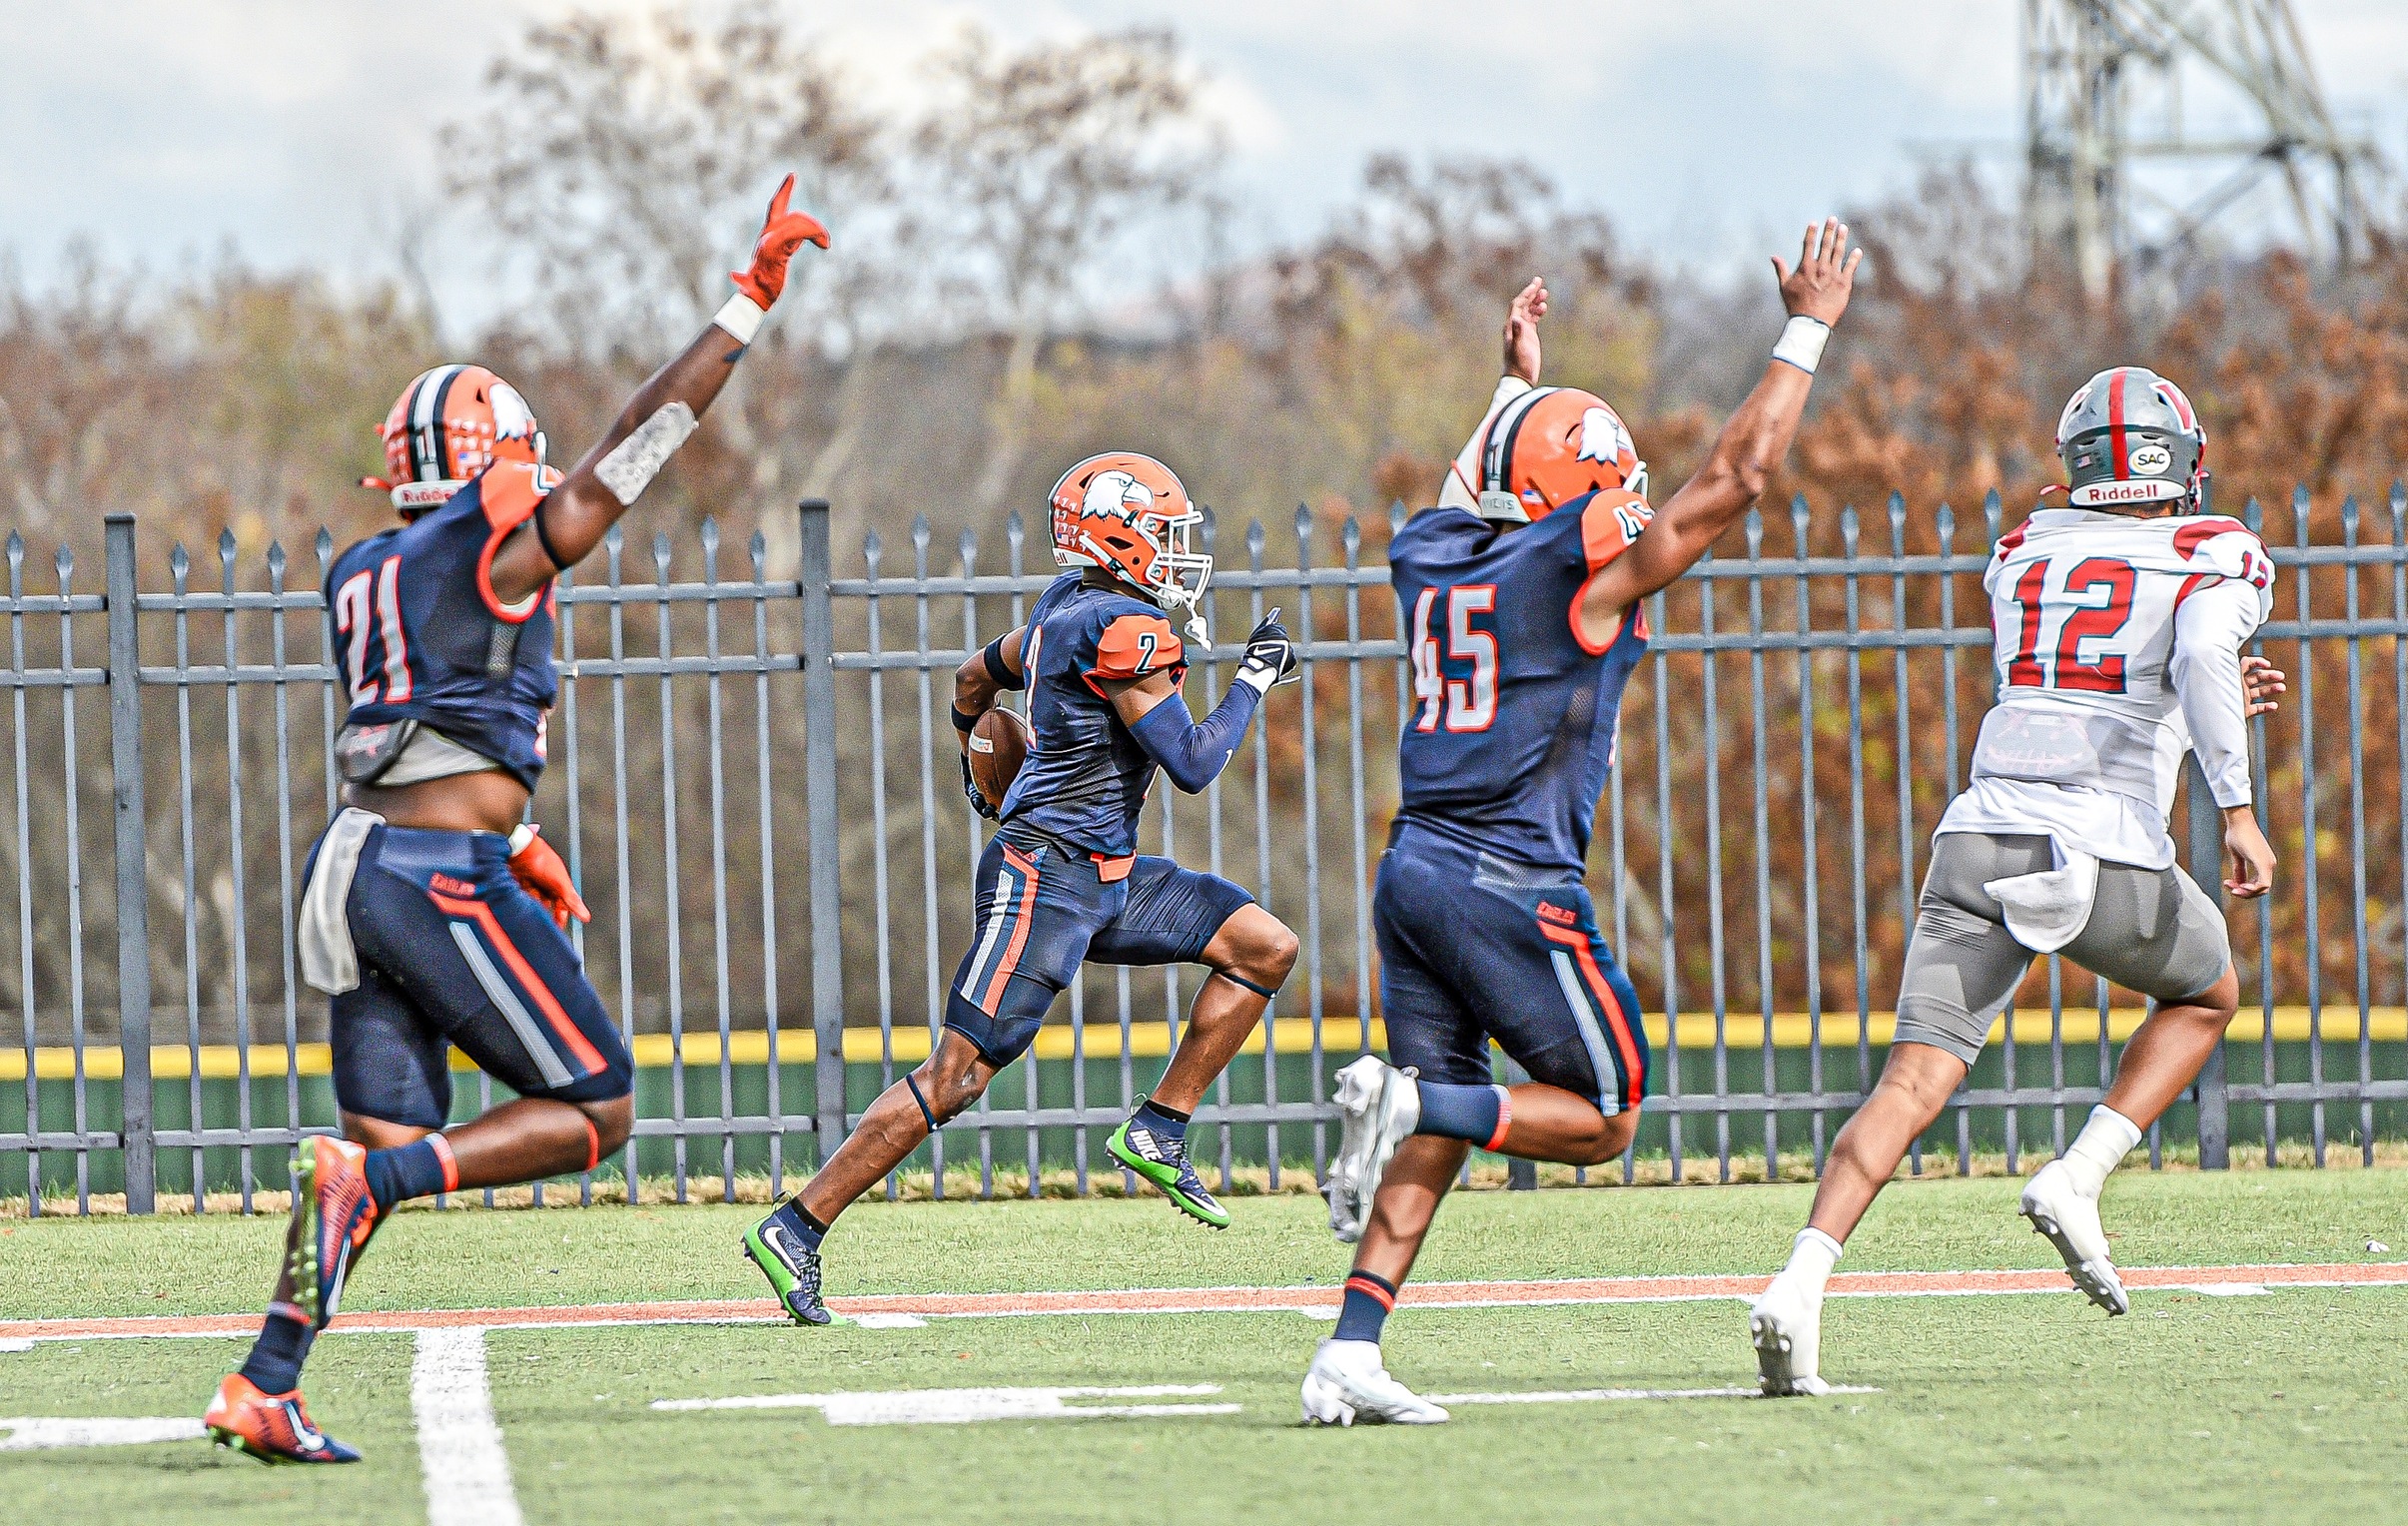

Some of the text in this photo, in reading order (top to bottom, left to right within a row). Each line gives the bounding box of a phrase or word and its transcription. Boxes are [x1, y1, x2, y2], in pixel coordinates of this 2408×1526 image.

[2136, 452, 2166, 466] SAC
[2088, 484, 2159, 501] Riddell
[336, 555, 413, 710] 21
[2008, 556, 2138, 694] 12
[1134, 631, 1159, 675] 2
[1411, 583, 1500, 733] 45
[1129, 1129, 1165, 1162] NIKE
